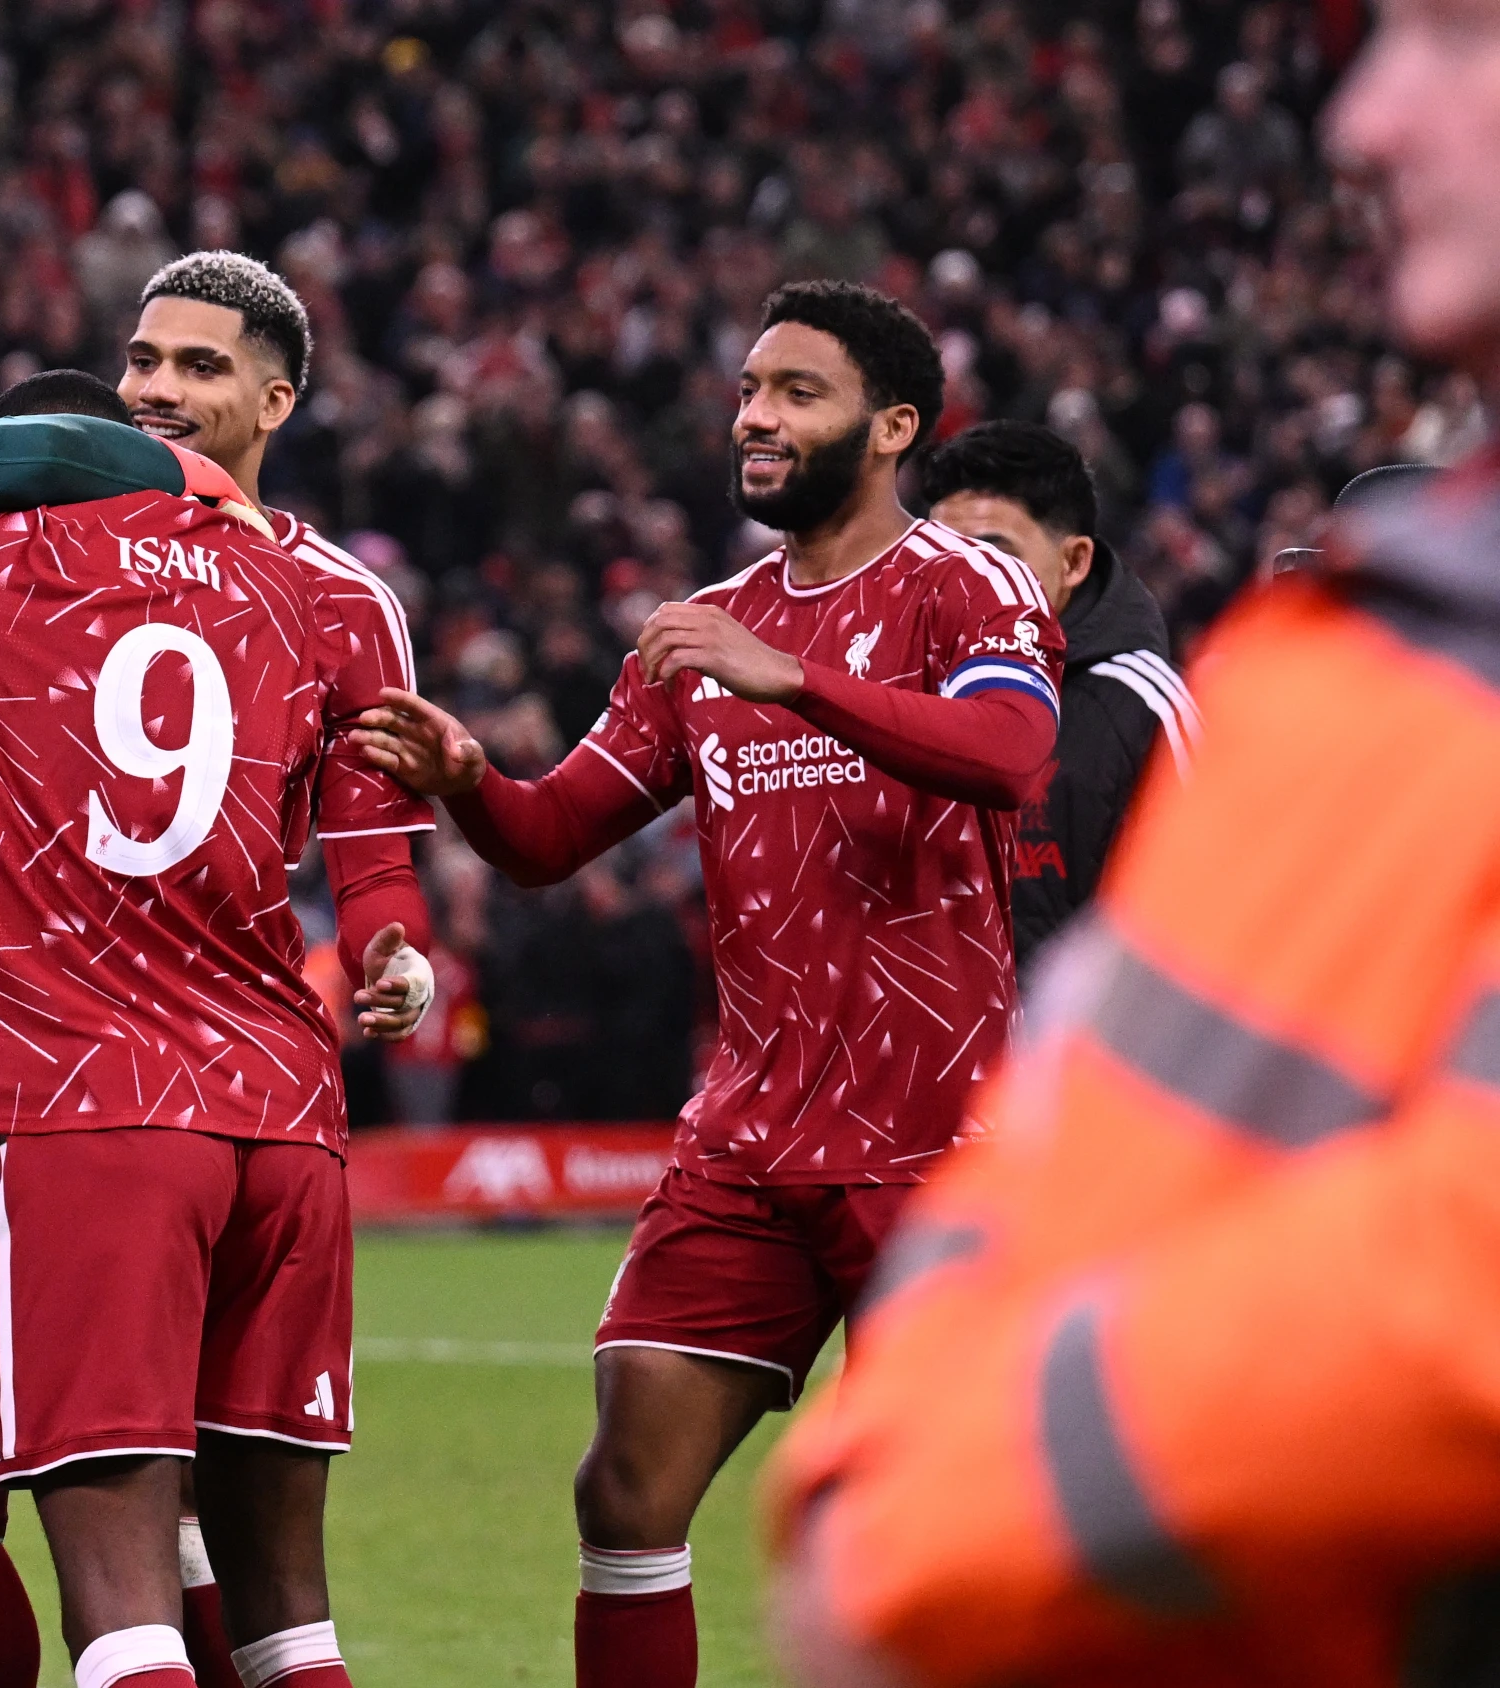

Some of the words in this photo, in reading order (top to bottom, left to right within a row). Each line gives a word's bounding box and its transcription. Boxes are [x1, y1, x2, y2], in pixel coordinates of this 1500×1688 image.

[118, 536, 221, 593] ISAK
[85, 622, 234, 877] 9
[737, 755, 866, 795] chartered
